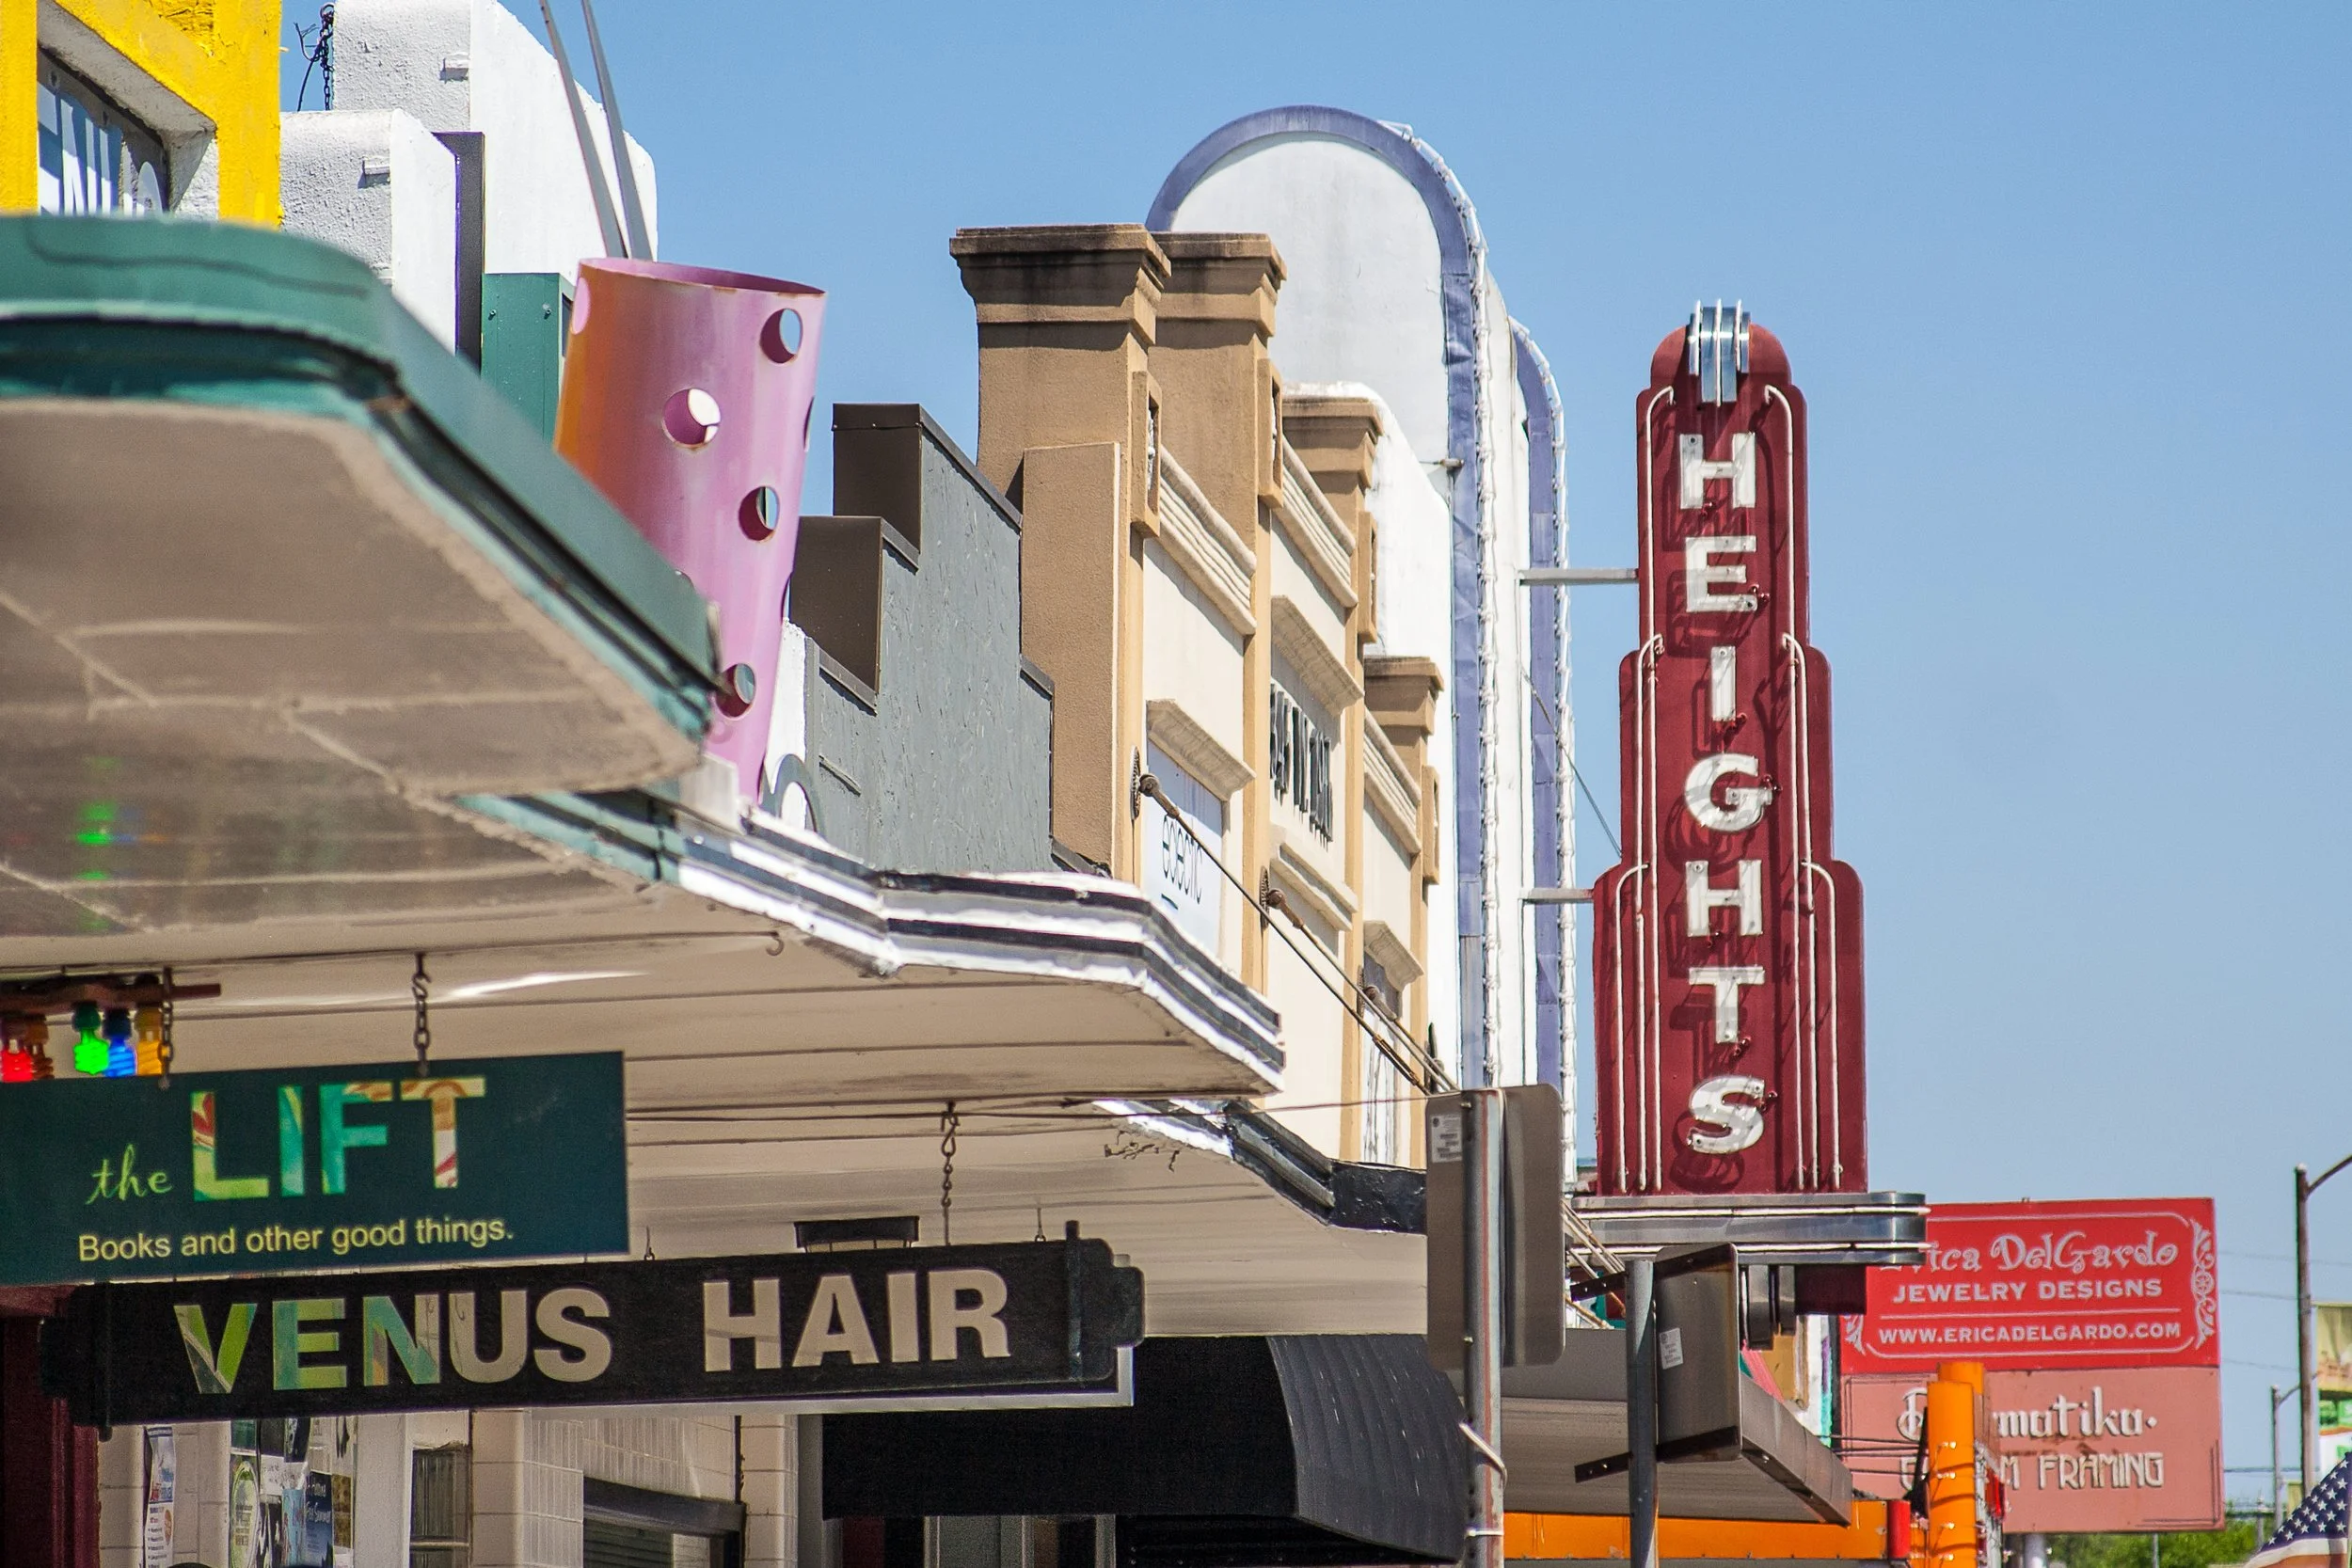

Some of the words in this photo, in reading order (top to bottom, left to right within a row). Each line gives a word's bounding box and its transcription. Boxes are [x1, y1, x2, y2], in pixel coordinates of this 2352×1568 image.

[1679, 432, 1773, 1154] HEIGHTS
[86, 1143, 173, 1205] the
[190, 1075, 486, 1202] LIFT
[79, 1233, 171, 1261] Books
[182, 1227, 235, 1256] and
[246, 1226, 323, 1252] other
[331, 1218, 405, 1255] good
[415, 1215, 514, 1248] things.
[1880, 1241, 1982, 1273] ica
[1990, 1229, 2179, 1274] DelGardo
[1893, 1281, 2026, 1304] JEWELRY
[2039, 1278, 2163, 1300] DESIGNS
[173, 1288, 612, 1395] VENUS
[702, 1268, 1012, 1373] HAIR
[1879, 1323, 2181, 1343] WWW.ERICADELGARDO.COM
[2039, 1452, 2164, 1490] FRAMING
